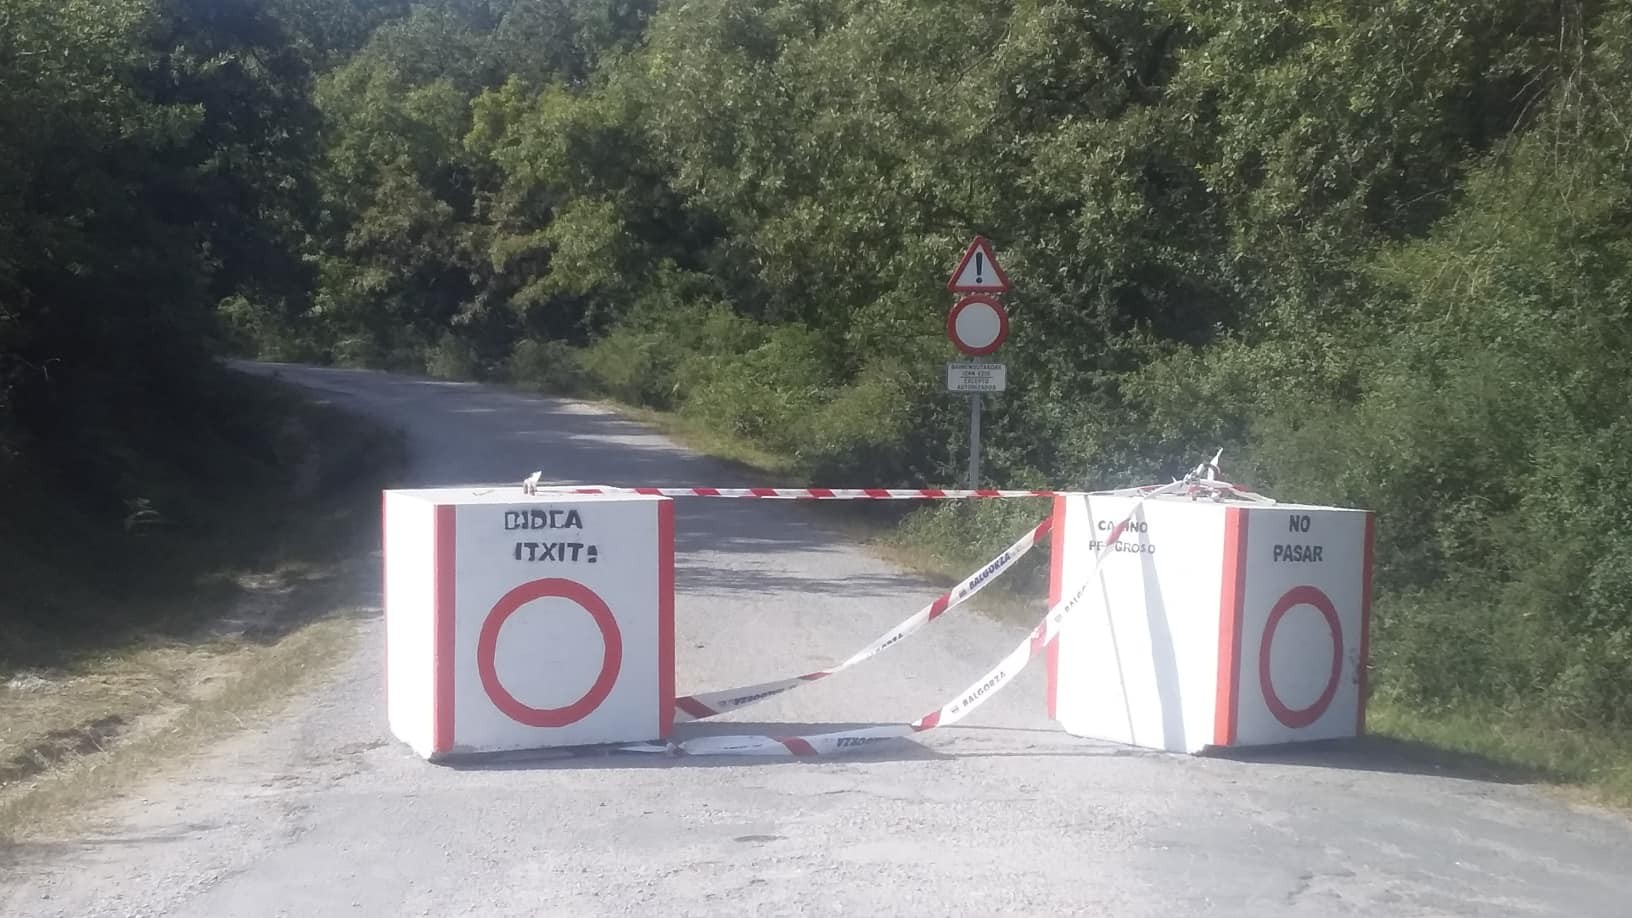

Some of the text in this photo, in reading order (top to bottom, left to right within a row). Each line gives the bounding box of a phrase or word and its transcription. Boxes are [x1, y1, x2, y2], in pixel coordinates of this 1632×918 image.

[1289, 514, 1311, 533] NO
[1273, 544, 1323, 563] PASAR
[968, 552, 1011, 591] BALGORZA
[962, 671, 1006, 707] BALGORZA
